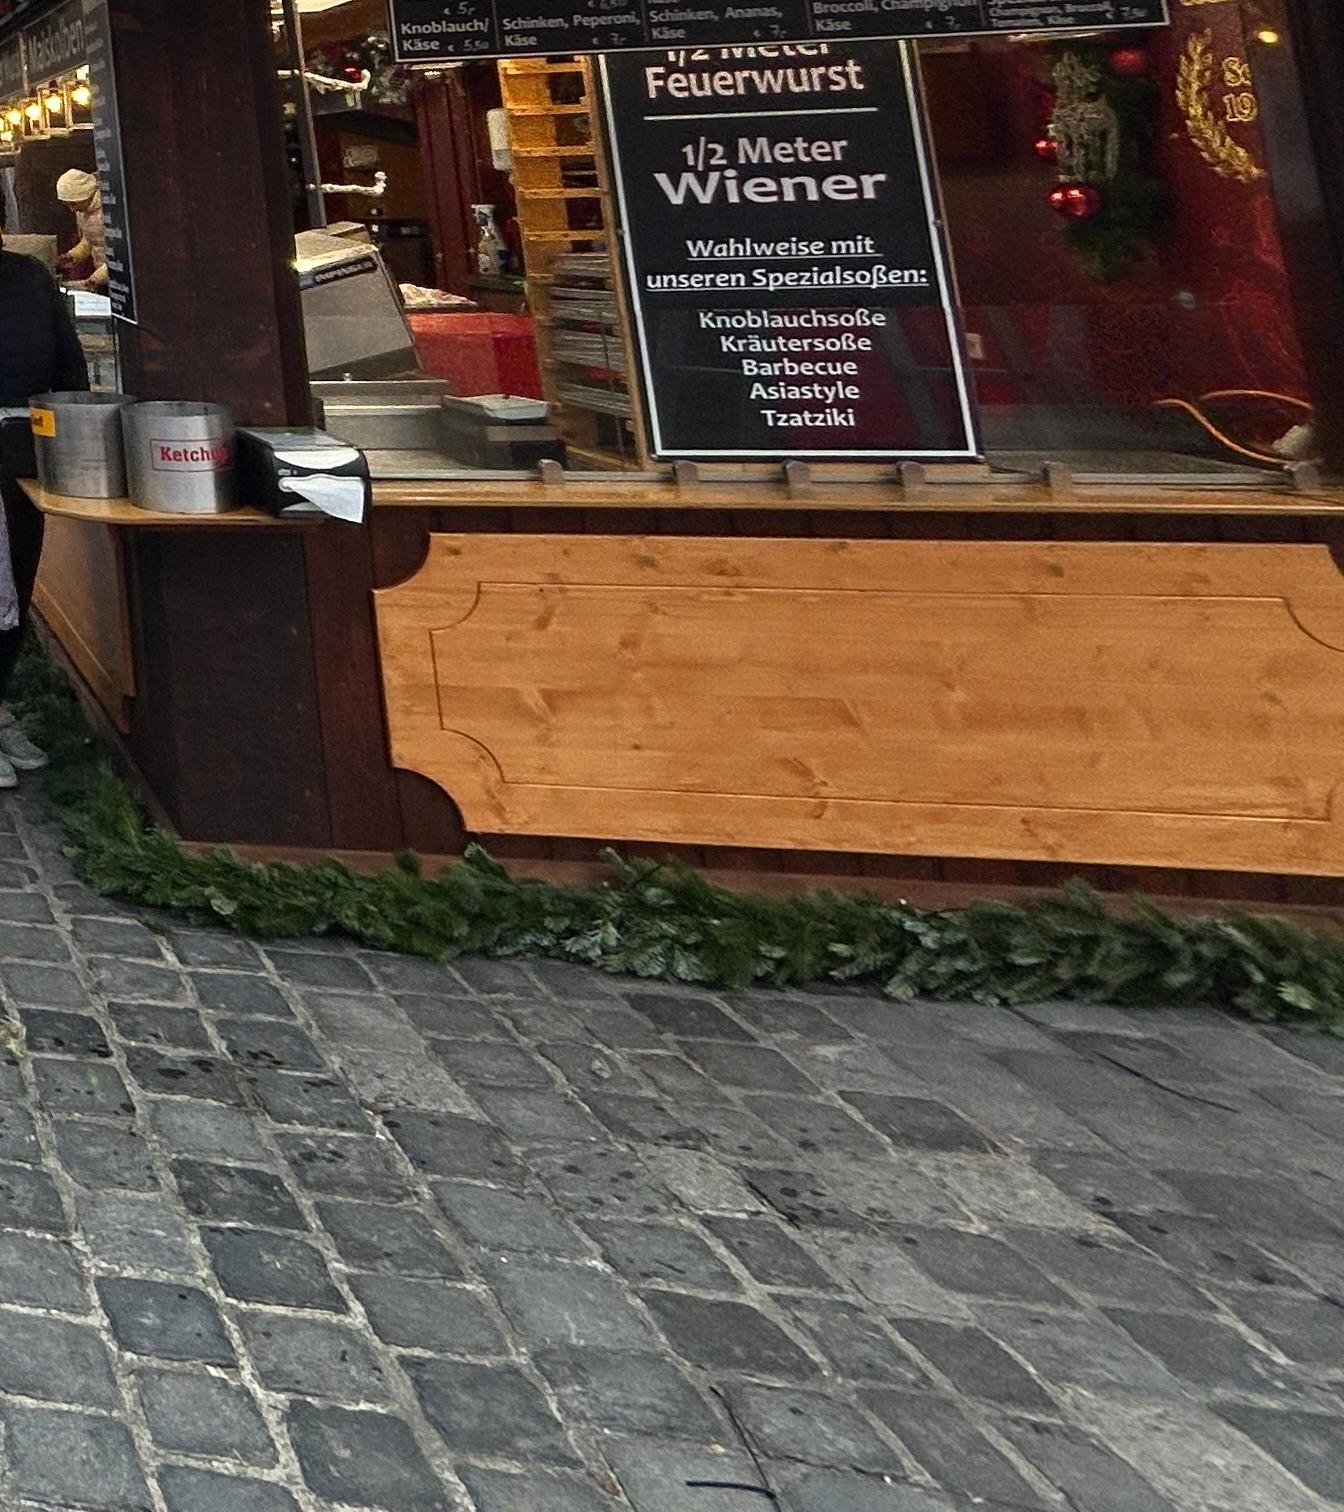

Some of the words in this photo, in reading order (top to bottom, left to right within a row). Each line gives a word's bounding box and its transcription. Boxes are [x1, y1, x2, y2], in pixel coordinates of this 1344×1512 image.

[502, 17, 569, 31] Schinken,
[573, 12, 641, 29] Peperoni,
[649, 7, 719, 23] Schinken,
[725, 5, 783, 19] Ananas,
[400, 18, 489, 35] Knoblauch/
[651, 26, 686, 39] Käse
[815, 18, 851, 32] Käse
[403, 39, 440, 51] Käse
[504, 34, 538, 47] Käse
[644, 59, 865, 99] Feuerwurst
[681, 136, 728, 171] 1/2
[737, 136, 849, 164] Meter
[652, 169, 887, 205] Wiener
[686, 237, 825, 258] Wahlweise
[831, 235, 874, 255] mit
[646, 270, 746, 289] unseren
[752, 266, 927, 291] Spezialsoßen:
[698, 308, 887, 329] Knoblauchsoße
[721, 332, 872, 353] Kräutersoße
[742, 357, 858, 377] Barbecue
[749, 382, 860, 404] Asiastyle
[761, 408, 855, 428] Tzatziki
